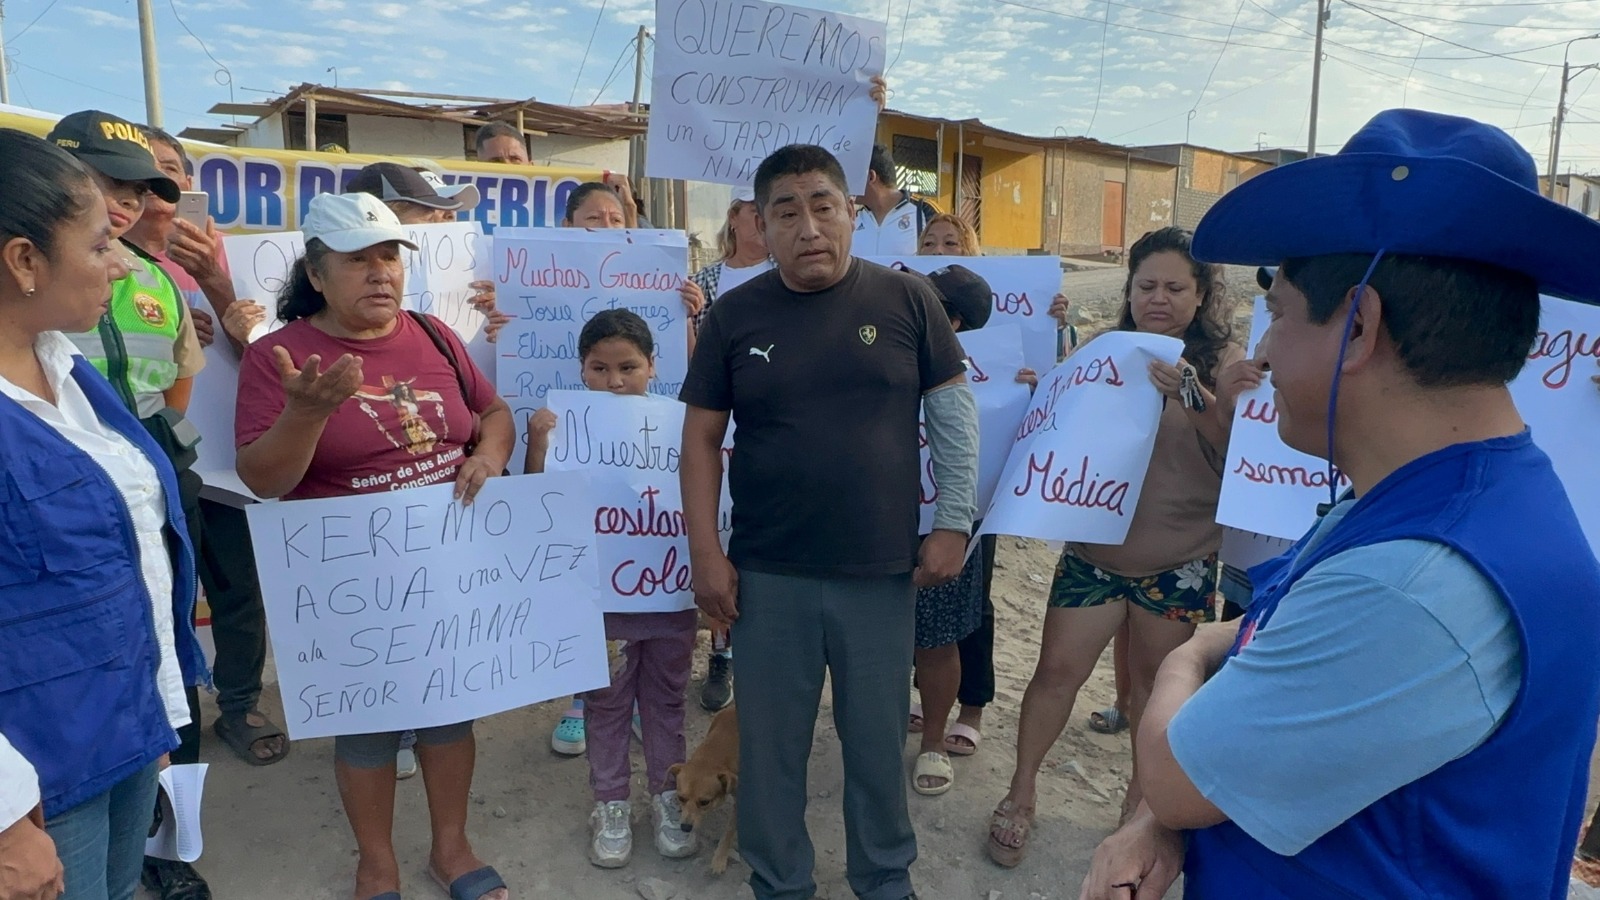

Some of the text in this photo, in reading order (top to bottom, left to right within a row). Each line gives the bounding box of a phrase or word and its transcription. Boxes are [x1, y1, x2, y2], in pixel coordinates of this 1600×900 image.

[673, 0, 880, 75] QUEREMOS
[670, 71, 860, 117] CONSTRUYAN
[666, 119, 851, 155] un JARDIN de
[499, 246, 590, 290] Muchas
[518, 295, 575, 322] Josue
[352, 471, 393, 489] Señor
[396, 466, 413, 479] de
[415, 460, 434, 473] las
[1013, 450, 1130, 518] Médica
[281, 491, 565, 568] KEREMOS
[295, 566, 435, 623] AGUA
[458, 567, 502, 594] una
[339, 597, 532, 667] SEMANA
[299, 680, 399, 724] SEÑOR
